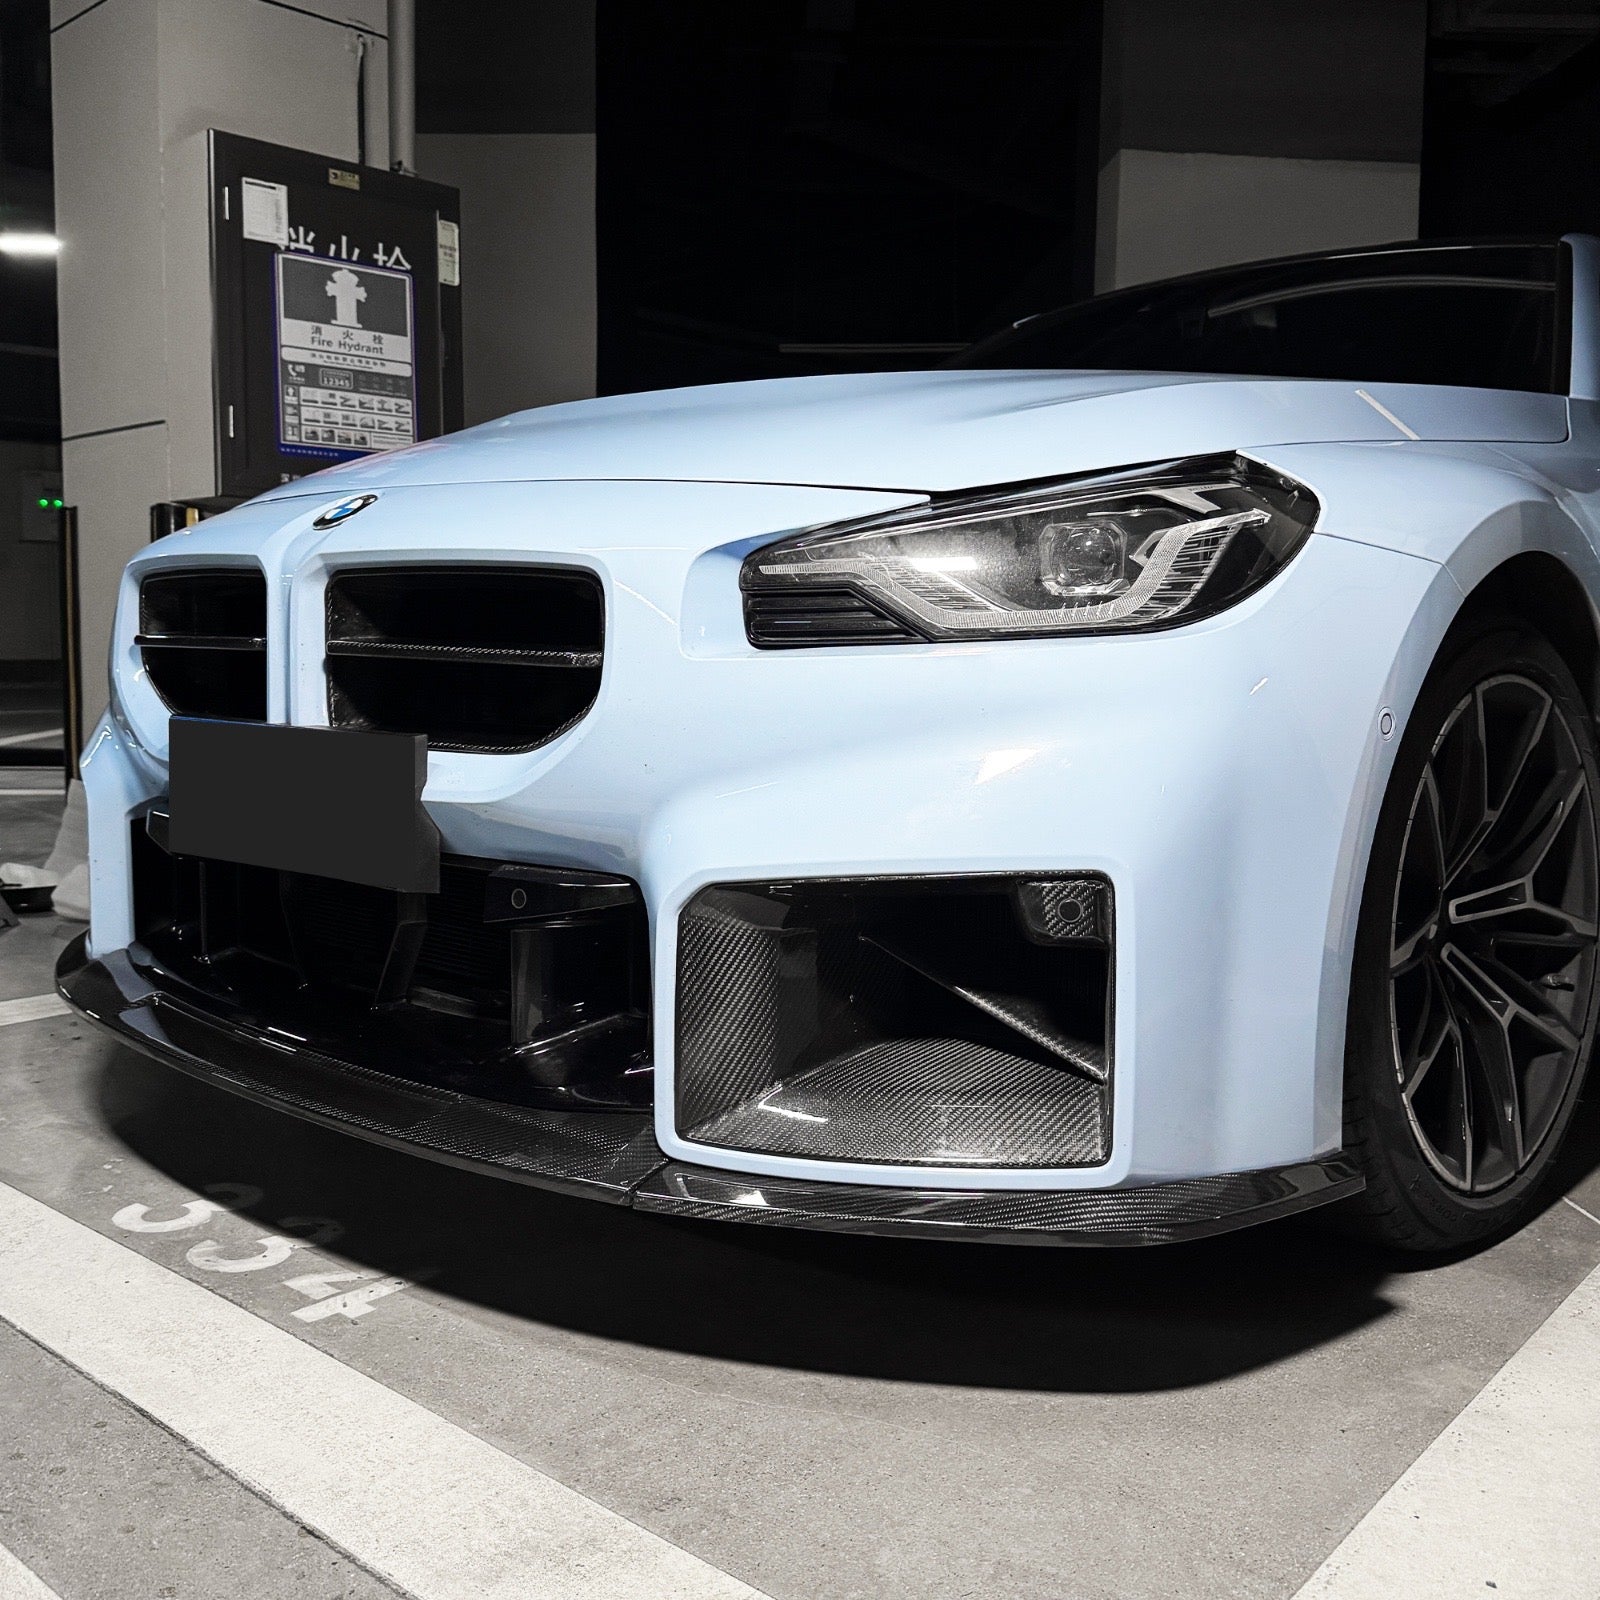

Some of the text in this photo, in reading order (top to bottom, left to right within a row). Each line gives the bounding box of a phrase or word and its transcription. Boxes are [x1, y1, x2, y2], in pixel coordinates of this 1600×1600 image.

[311, 325, 384, 345] 消火栓
[311, 336, 384, 354] Fire Hydrant
